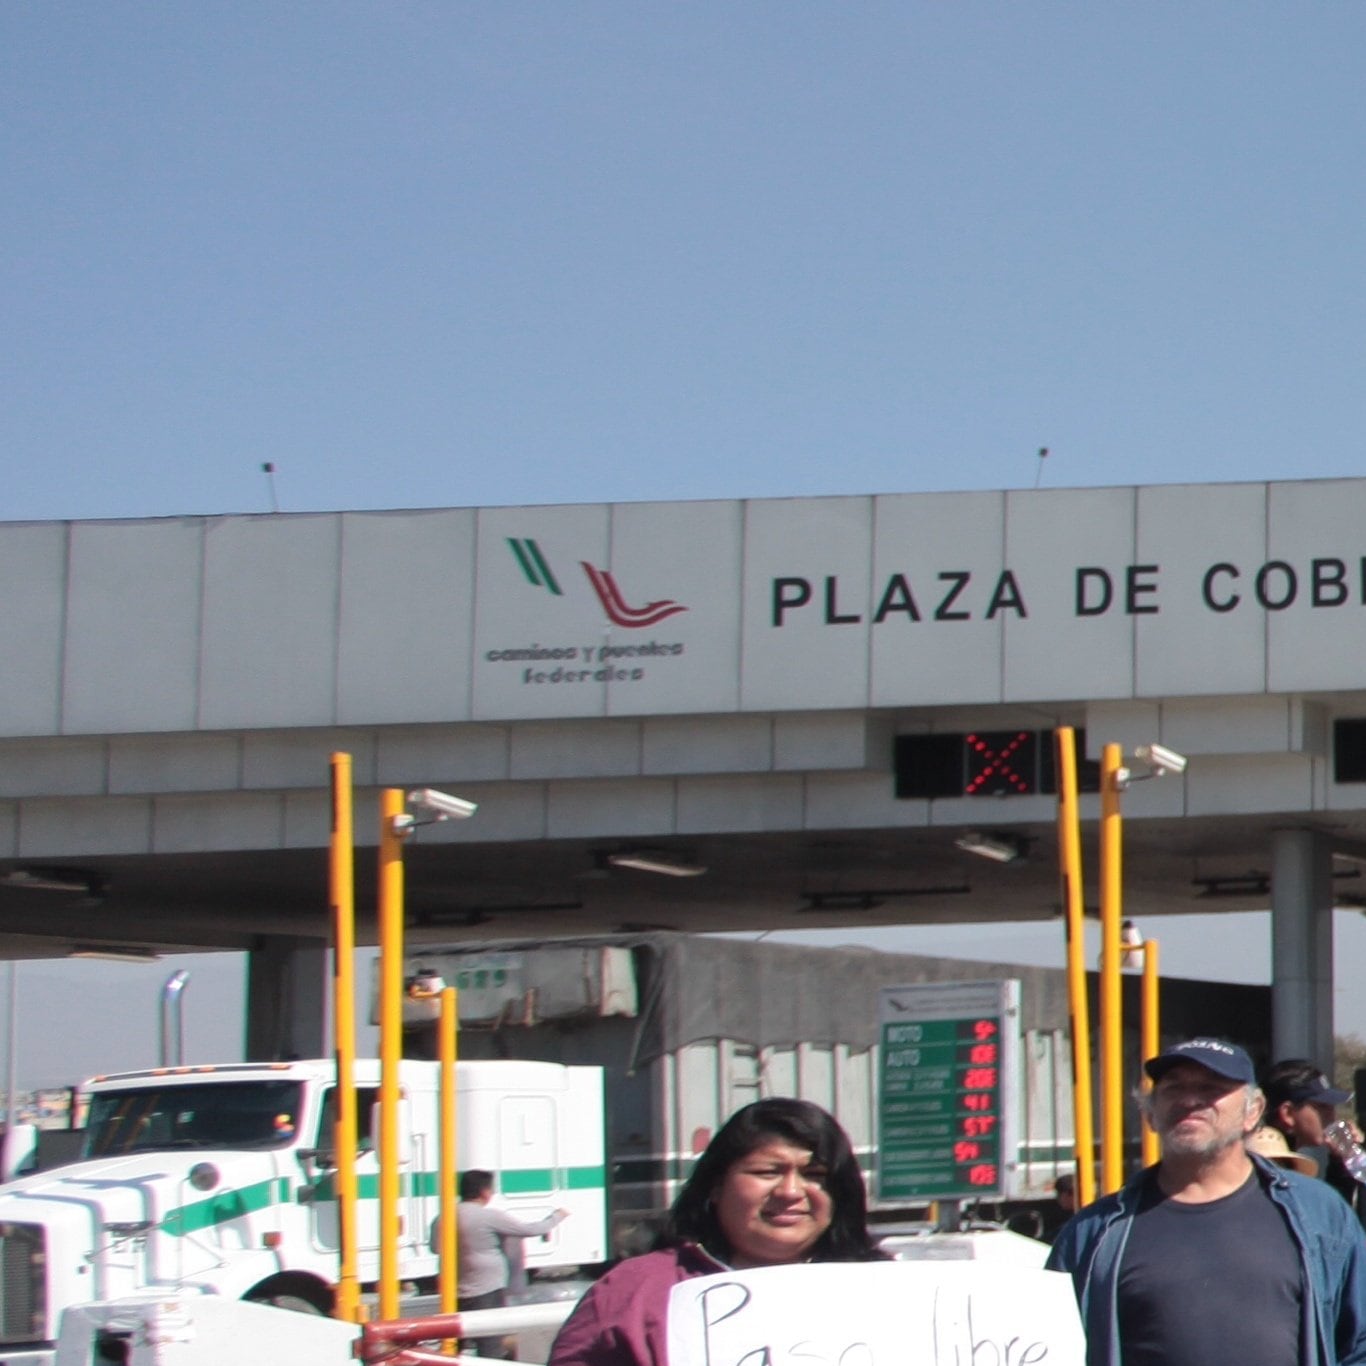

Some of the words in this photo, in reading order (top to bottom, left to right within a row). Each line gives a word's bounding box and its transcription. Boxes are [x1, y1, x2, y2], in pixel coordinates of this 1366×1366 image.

[773, 570, 1027, 627] PLAZA
[1075, 565, 1159, 616] DE
[524, 666, 644, 684] federales
[886, 1049, 921, 1067] AUTO
